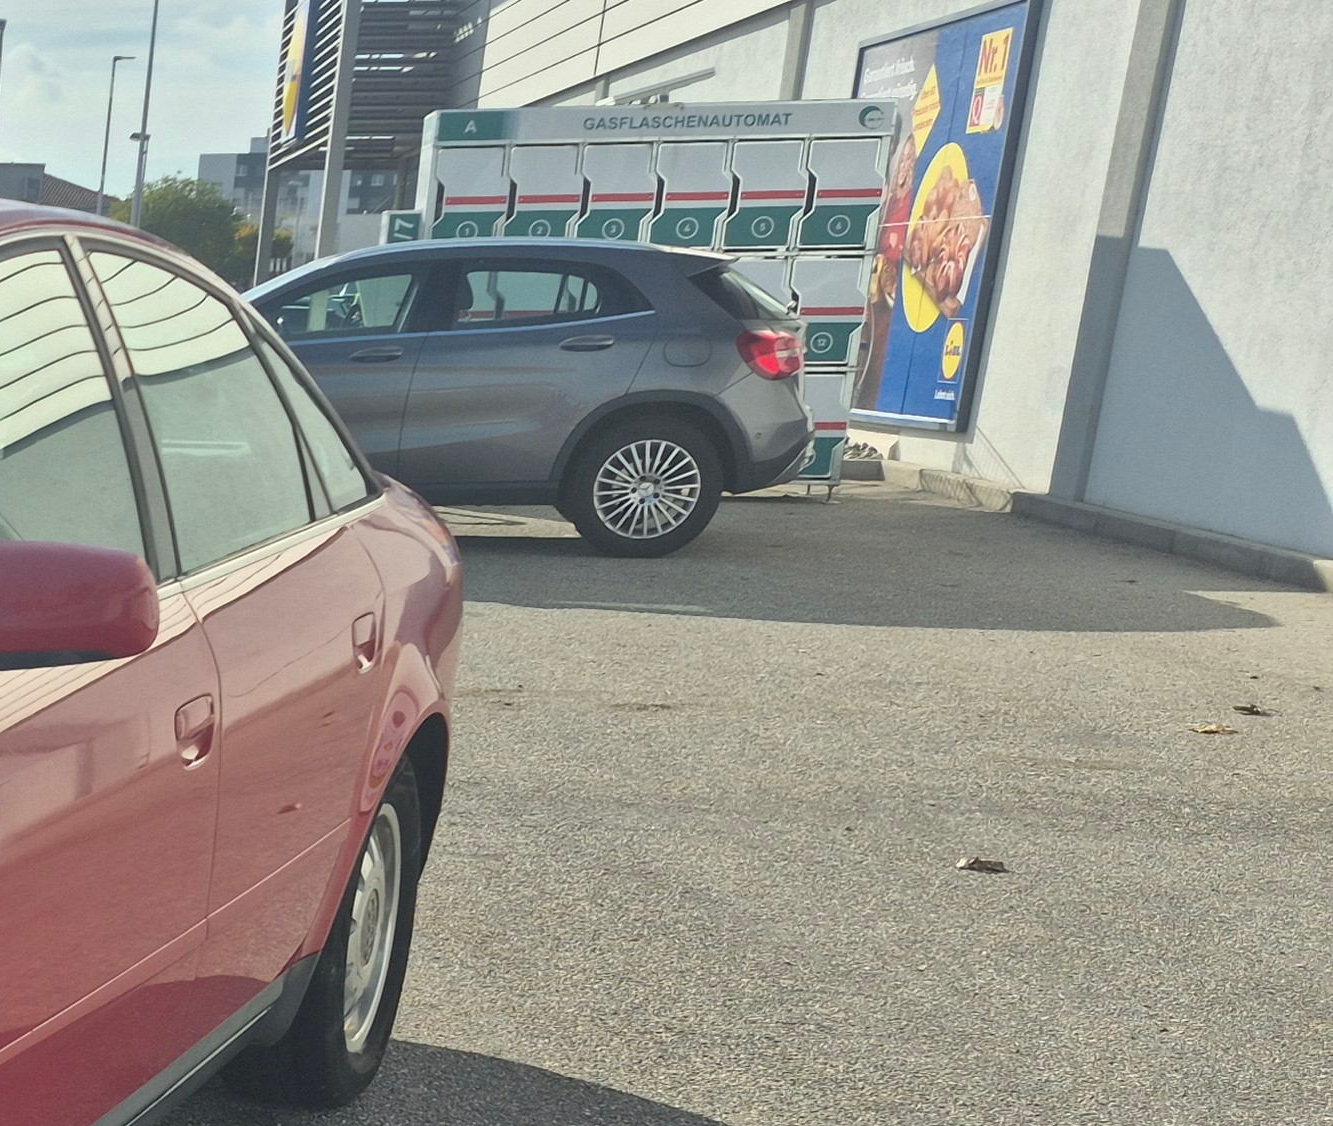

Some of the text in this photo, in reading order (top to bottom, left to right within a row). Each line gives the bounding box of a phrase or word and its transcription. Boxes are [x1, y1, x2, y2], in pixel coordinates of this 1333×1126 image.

[978, 33, 1010, 76] Nr. 1
[463, 119, 478, 134] A
[583, 112, 793, 131] GASFLASCHENAUTOMAT
